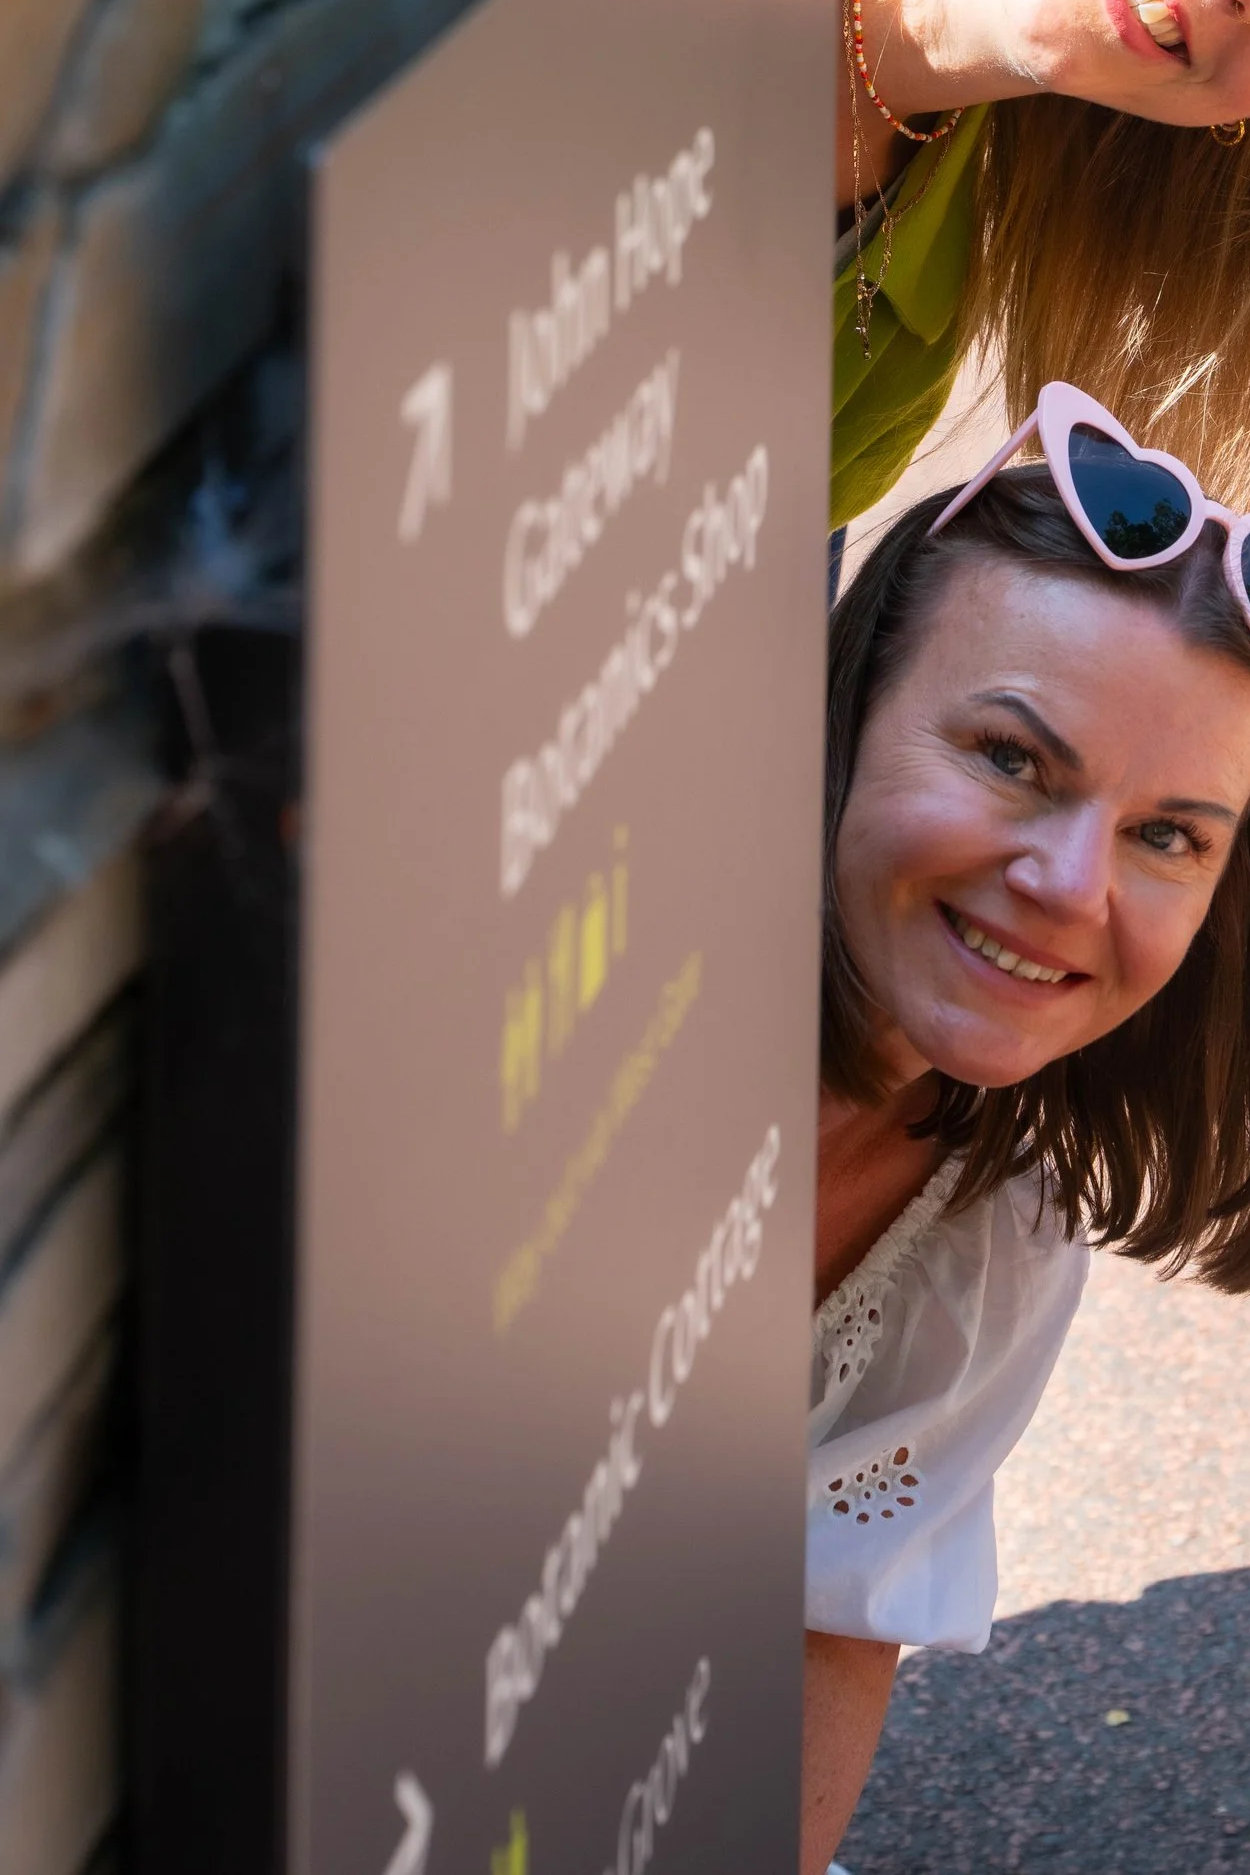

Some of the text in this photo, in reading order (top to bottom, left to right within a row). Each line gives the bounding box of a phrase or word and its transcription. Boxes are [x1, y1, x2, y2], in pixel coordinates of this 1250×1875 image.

[506, 125, 716, 448] John Hope
[501, 572, 680, 895] Botanics
[682, 443, 769, 629] Shop
[504, 349, 680, 639] Gateway
[485, 1392, 646, 1768] Botanic
[650, 1125, 781, 1429] Cottage
